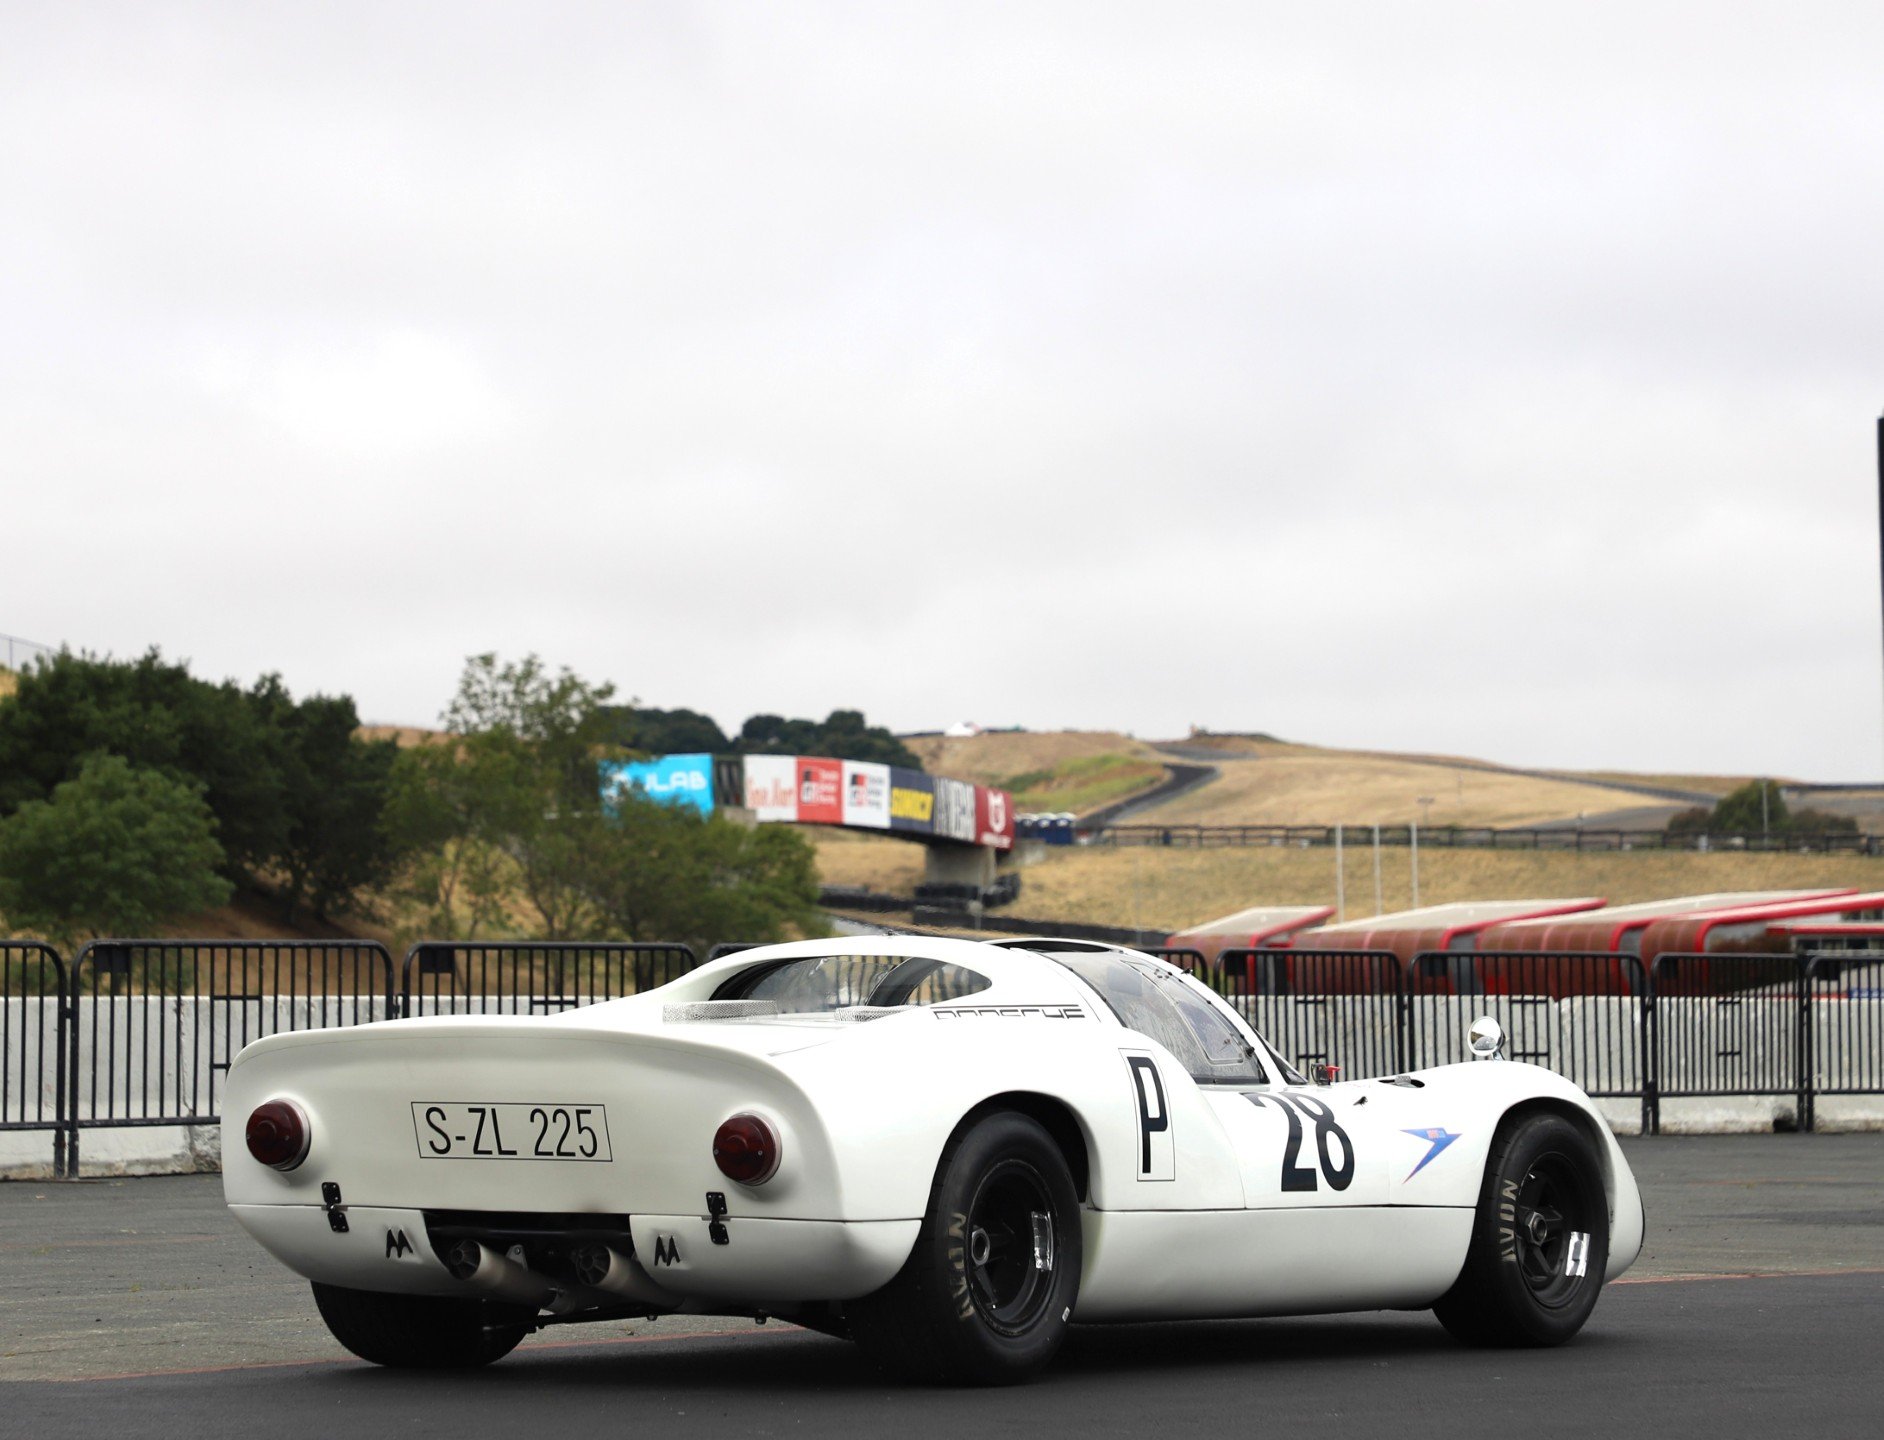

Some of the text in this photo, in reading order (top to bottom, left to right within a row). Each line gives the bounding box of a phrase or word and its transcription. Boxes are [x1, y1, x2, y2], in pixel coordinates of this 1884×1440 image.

[425, 1106, 598, 1158] S-ZL 225
[1126, 1056, 1169, 1174] P
[1239, 1090, 1355, 1192] 28
